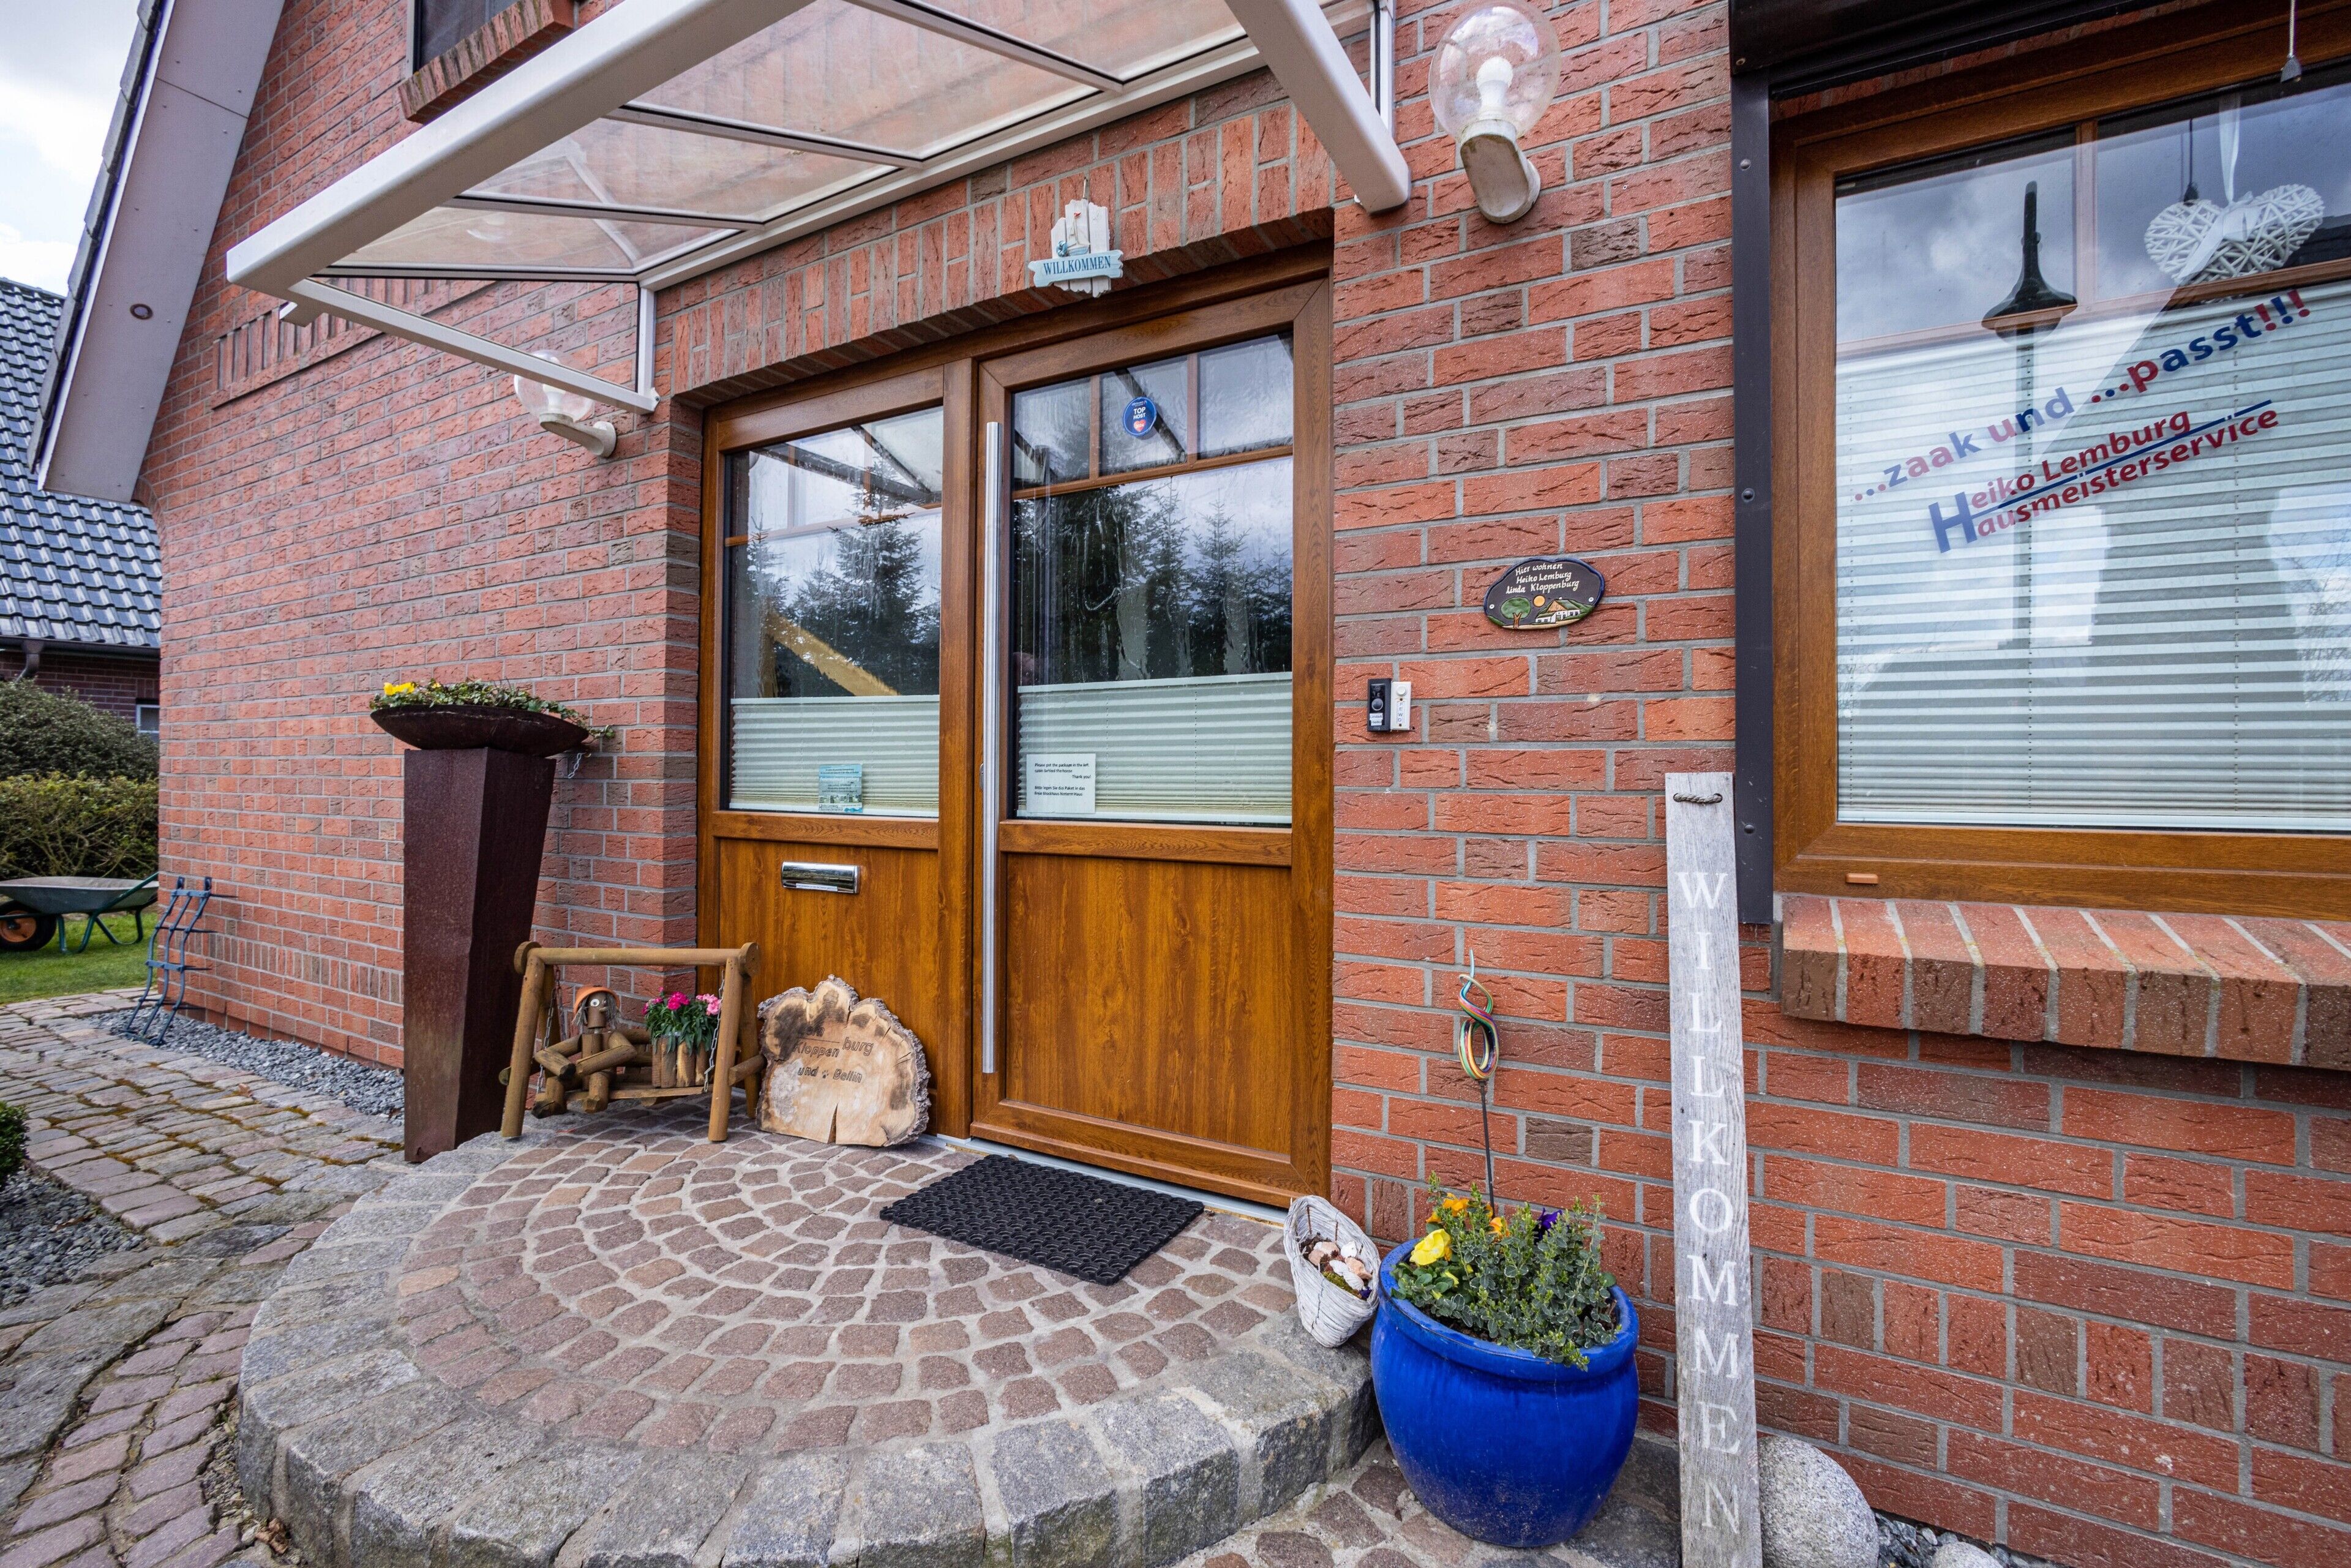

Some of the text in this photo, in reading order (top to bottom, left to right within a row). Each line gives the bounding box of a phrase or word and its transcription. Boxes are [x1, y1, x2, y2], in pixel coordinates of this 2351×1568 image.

[1043, 255, 1111, 276] WILLKOMMEN
[1854, 289, 2311, 501] ...zaak und ...passt!!!
[1928, 411, 2191, 553] Heiko Lemburg
[1515, 563, 1562, 576] Hier wohnen
[1516, 571, 1572, 584] Heiko Lemburg
[1505, 579, 1580, 594] Linda Kloppenburg
[793, 1041, 839, 1058] Kloppen
[842, 1037, 874, 1057] burg
[798, 1066, 863, 1083] und Bellin
[1674, 872, 1741, 1534] WILLKOMMEN
